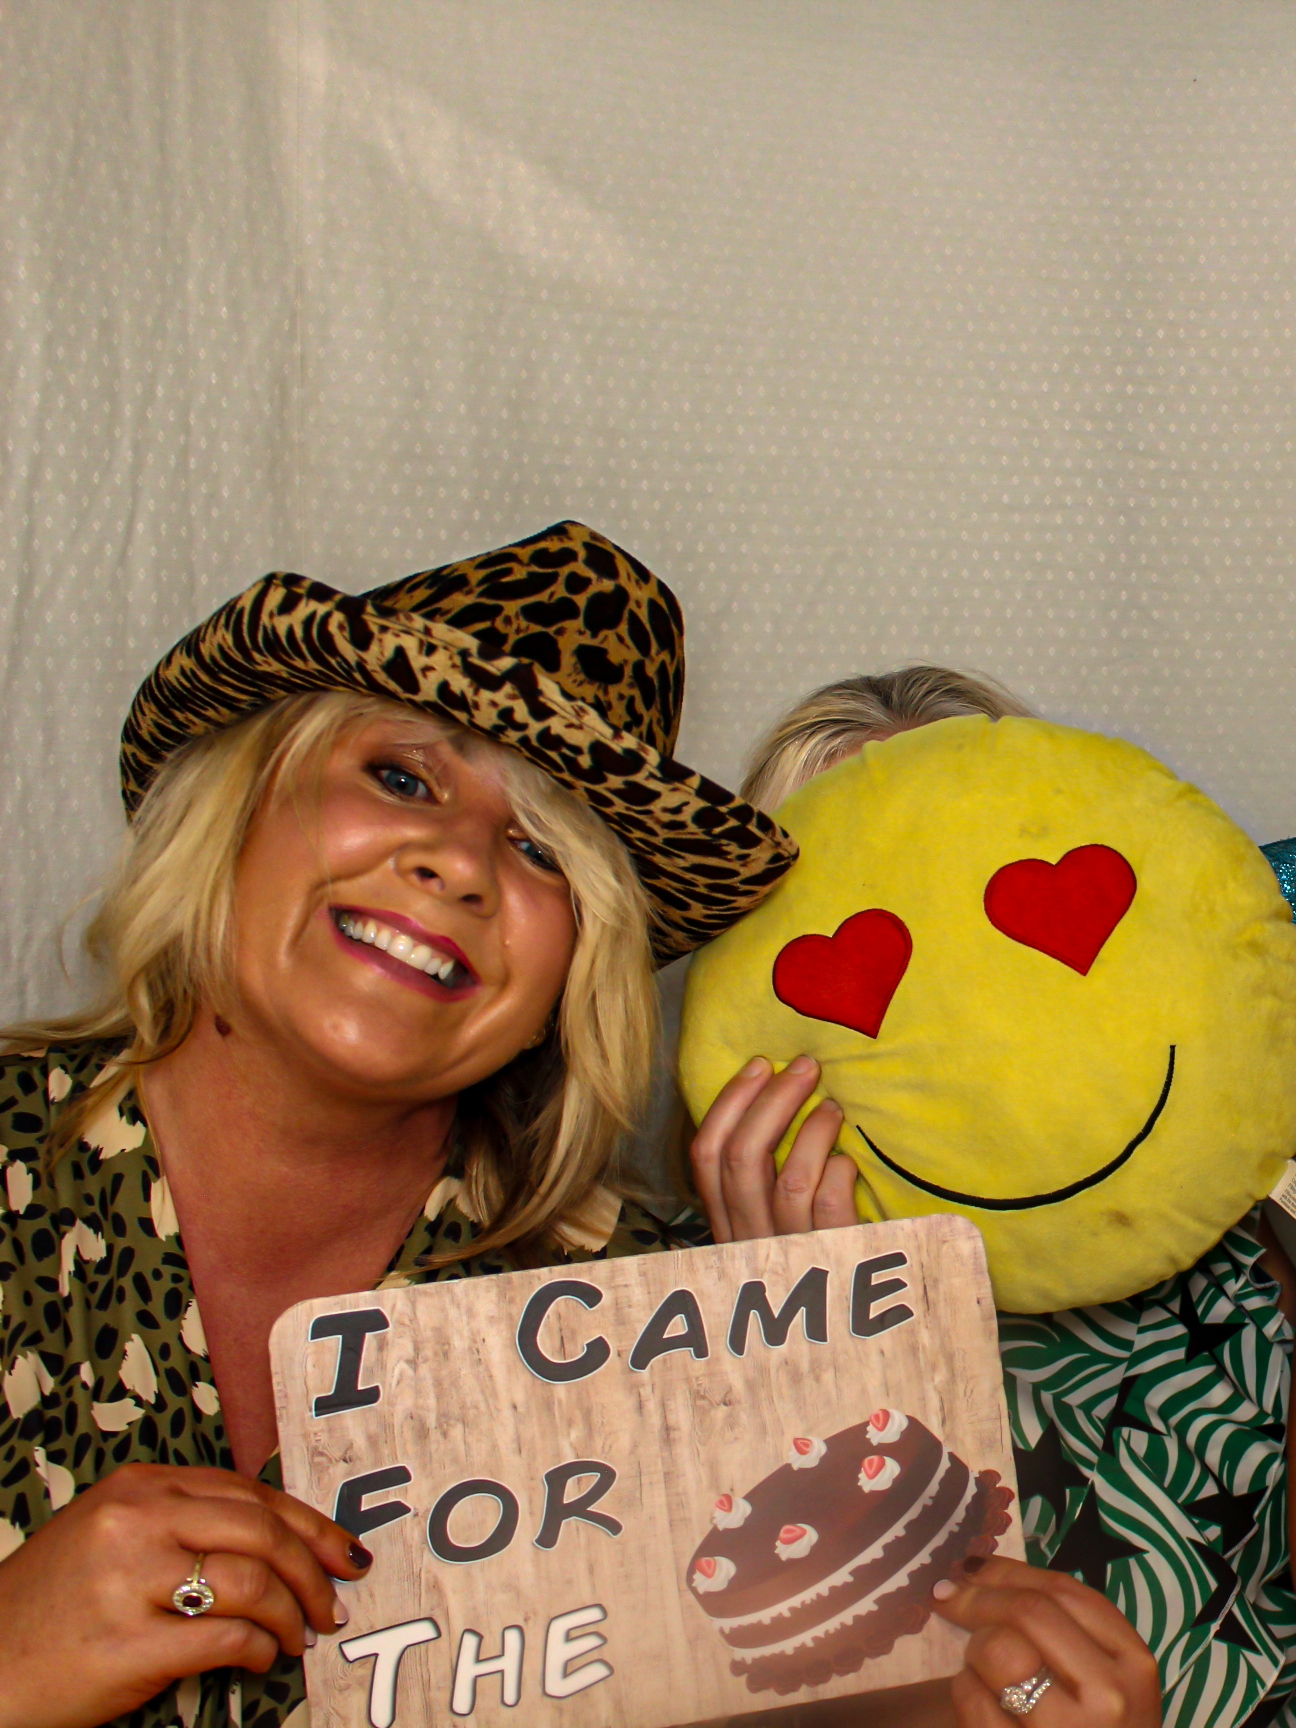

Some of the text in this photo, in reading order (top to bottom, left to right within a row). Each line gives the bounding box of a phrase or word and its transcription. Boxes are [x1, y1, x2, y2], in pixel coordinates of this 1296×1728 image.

[308, 1251, 915, 1418] I CAME
[333, 1458, 623, 1578] FOR
[339, 1602, 614, 1728] THE
